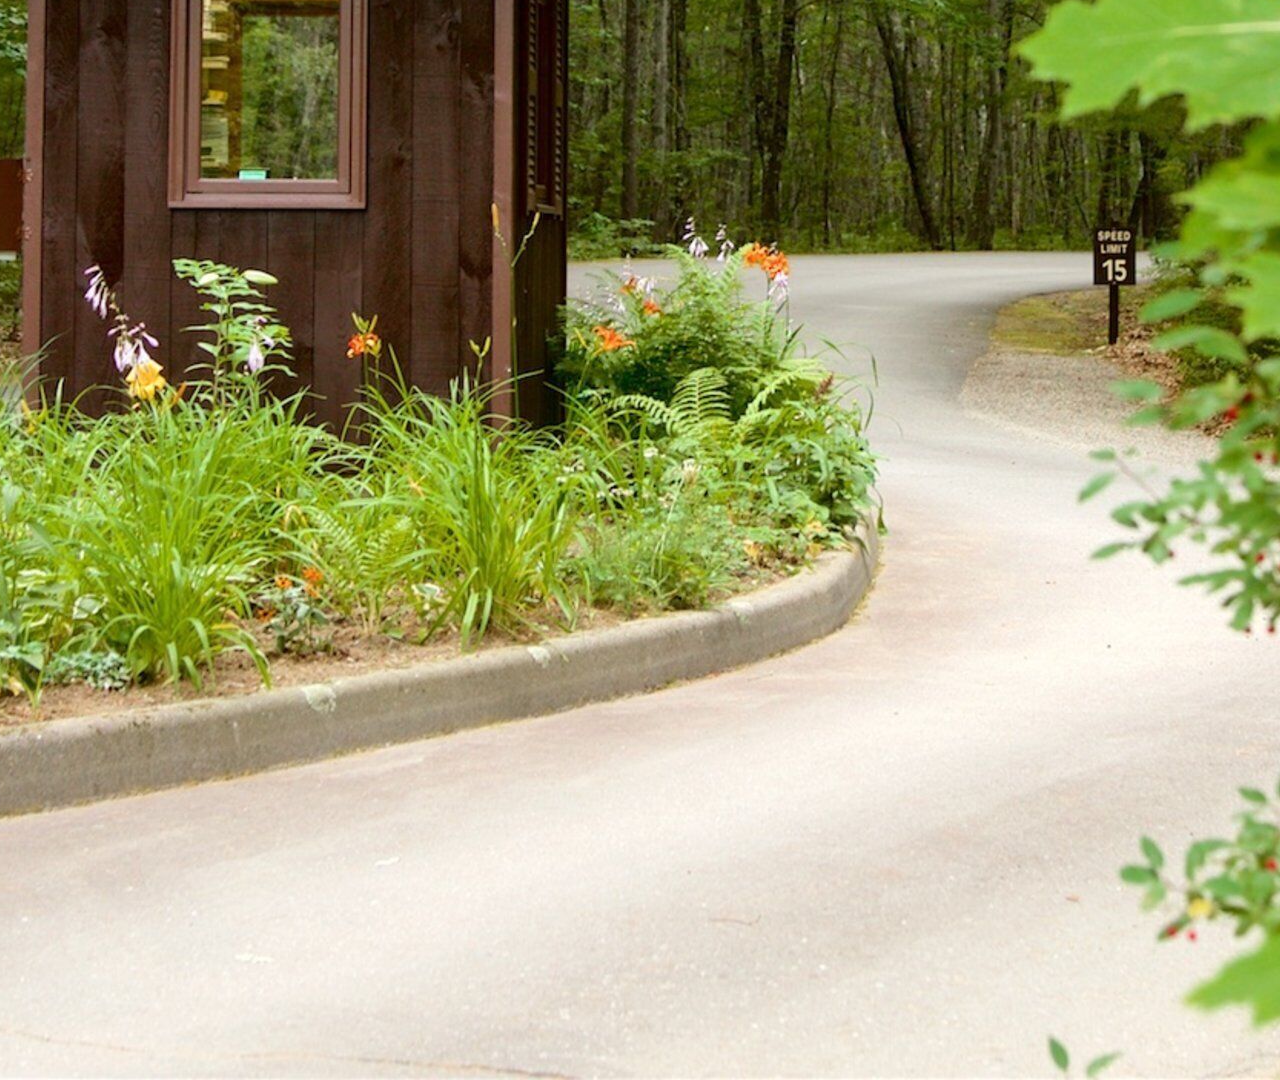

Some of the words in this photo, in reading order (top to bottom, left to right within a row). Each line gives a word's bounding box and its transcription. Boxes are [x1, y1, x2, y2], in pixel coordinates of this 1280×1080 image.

[1097, 230, 1131, 241] SPEED
[1100, 244, 1128, 254] LIMIT
[1102, 259, 1127, 281] 15
